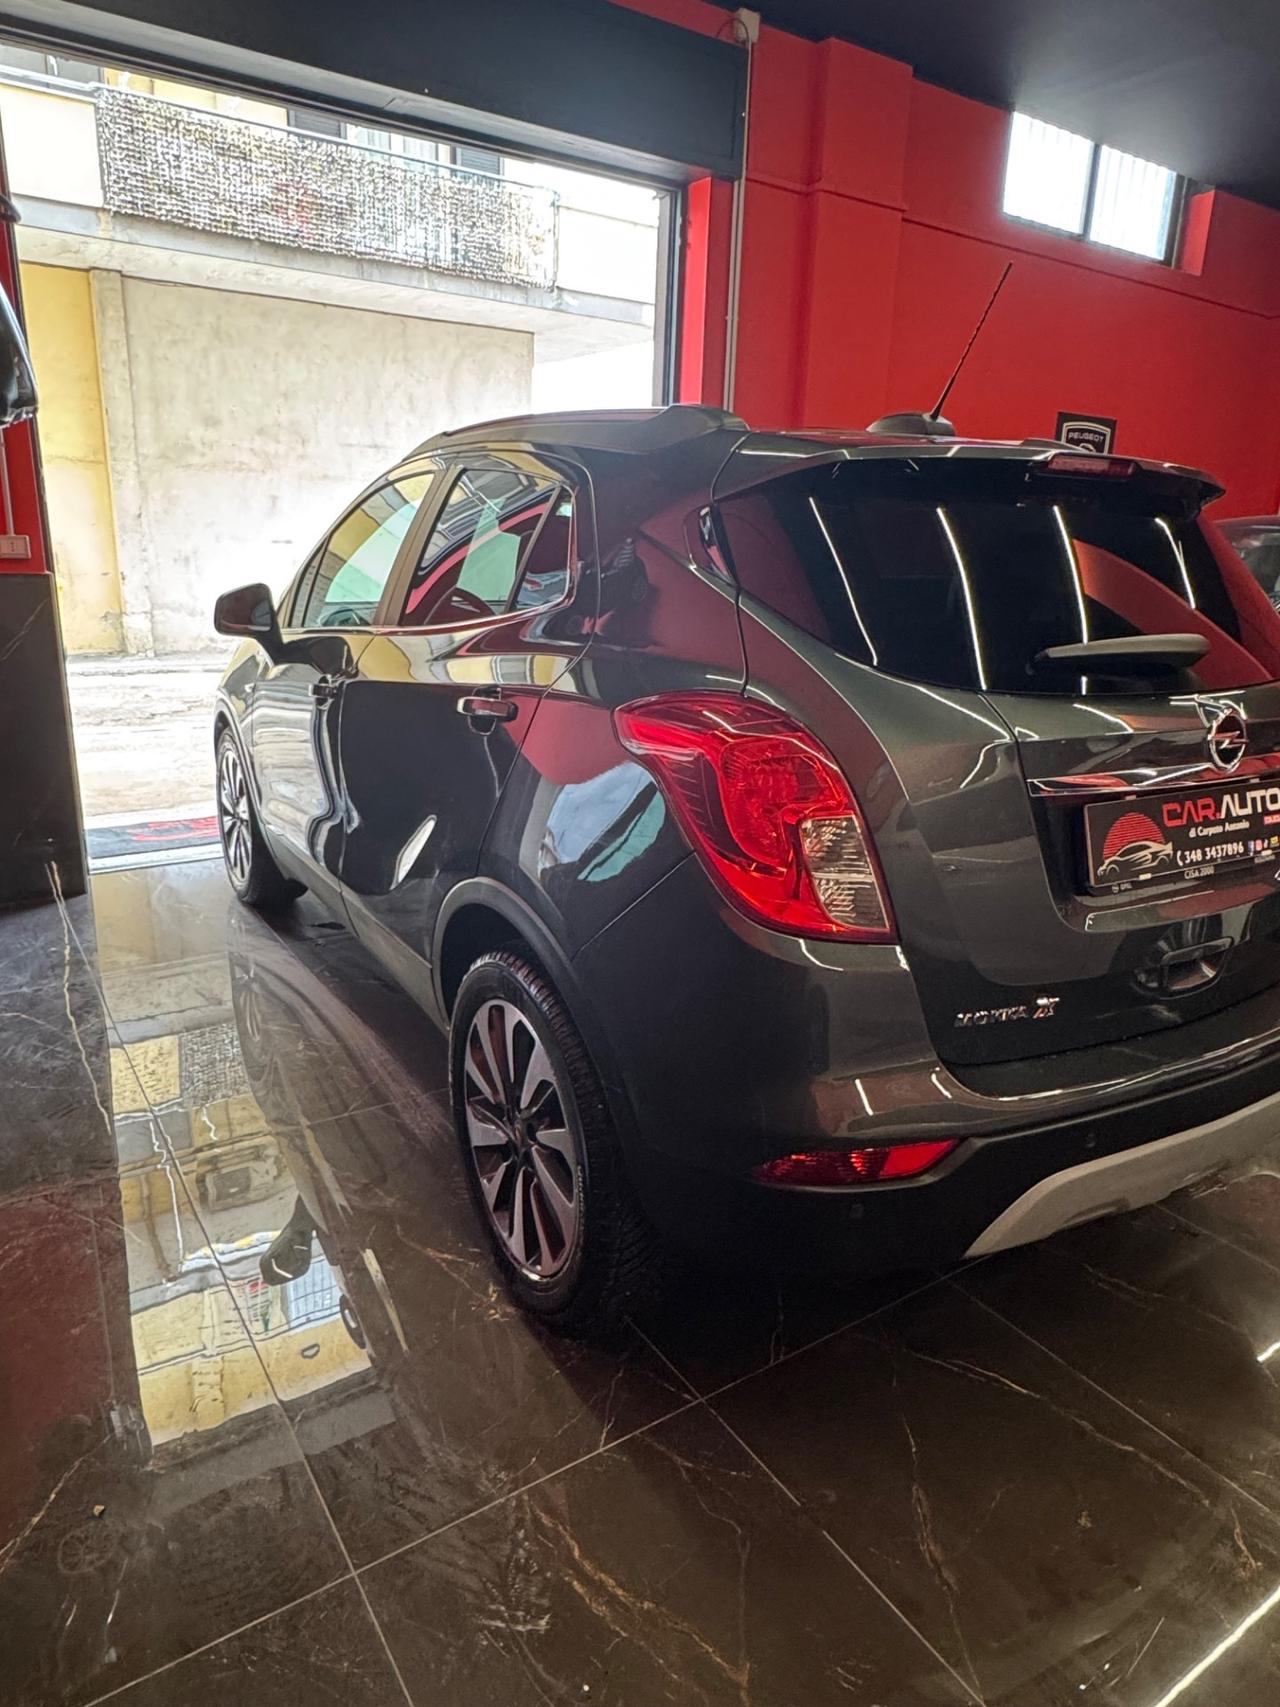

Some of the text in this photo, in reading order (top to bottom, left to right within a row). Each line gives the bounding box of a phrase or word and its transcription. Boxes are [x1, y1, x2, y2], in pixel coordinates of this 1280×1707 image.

[1068, 431, 1104, 442] PEUGEOT
[1189, 827, 1197, 839] di
[1184, 849, 1203, 864] 348
[1205, 841, 1245, 861] 3437896
